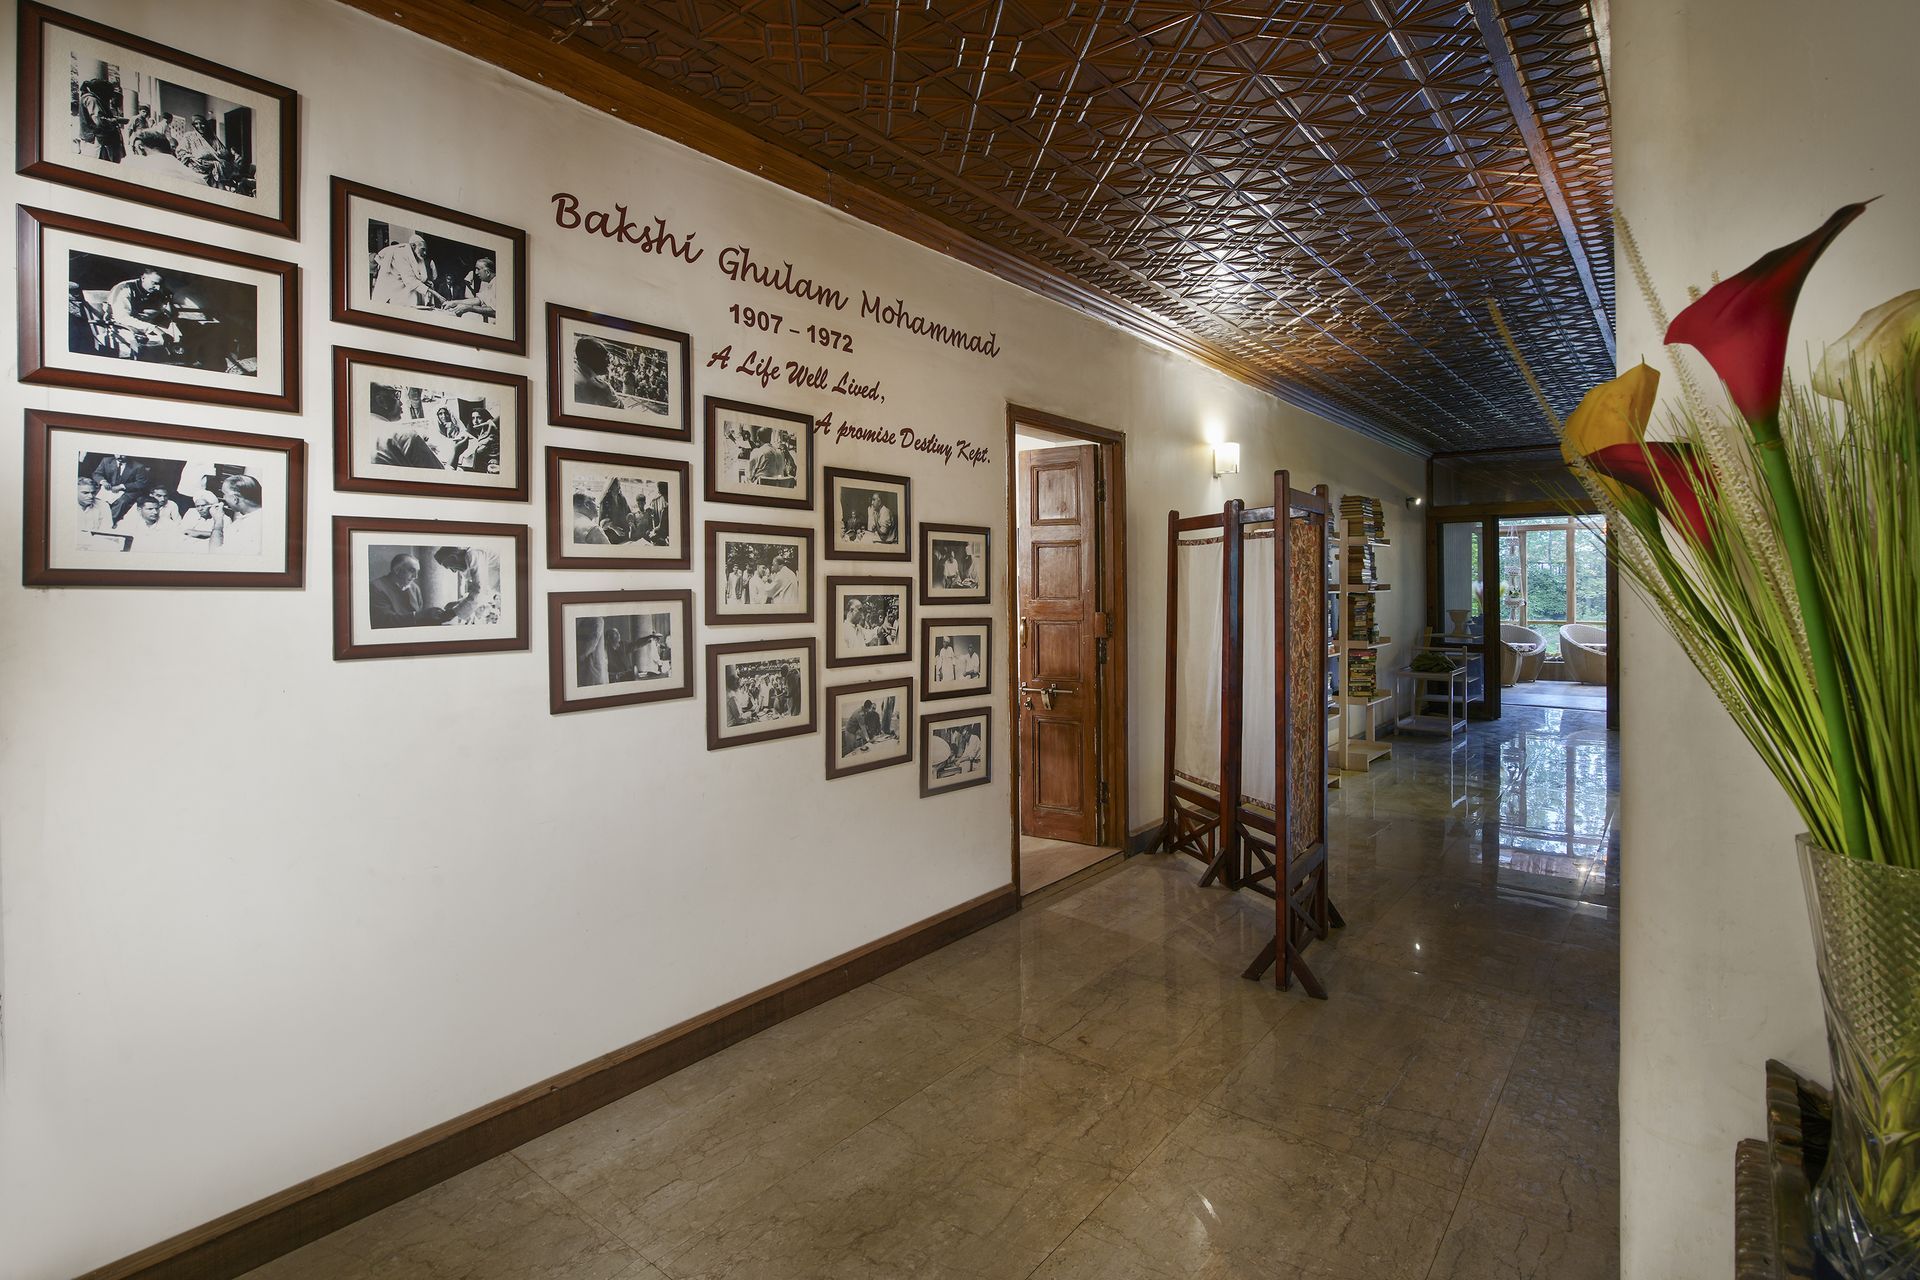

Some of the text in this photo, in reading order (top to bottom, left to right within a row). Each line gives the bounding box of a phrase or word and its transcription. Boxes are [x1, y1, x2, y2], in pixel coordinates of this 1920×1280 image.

[551, 192, 1001, 359] Bakshi Ghulam Mohammad
[729, 303, 784, 335] 1907
[806, 324, 854, 354] 1972
[706, 344, 886, 405] A Life Well Lived,
[814, 411, 991, 468] A promise Destiny Kept.
